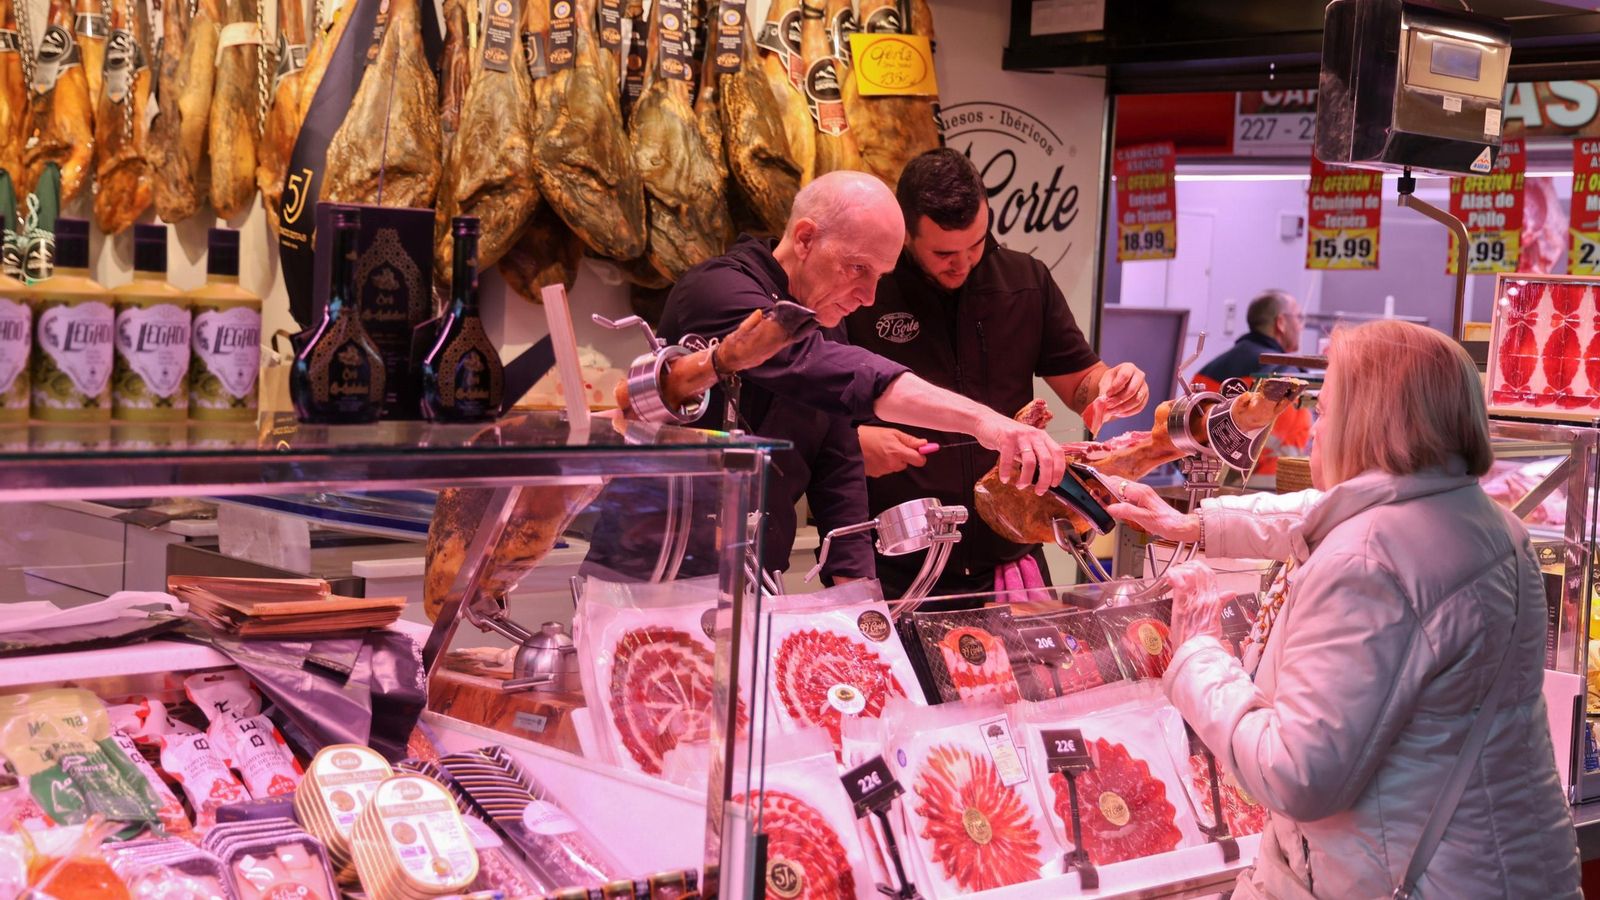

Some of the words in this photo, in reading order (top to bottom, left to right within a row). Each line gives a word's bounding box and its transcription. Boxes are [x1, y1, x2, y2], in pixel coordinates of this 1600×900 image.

[1503, 81, 1599, 128] AS
[943, 110, 984, 131] uesos
[1000, 110, 1054, 156] Ibéricos
[1241, 117, 1278, 141] 227
[1299, 116, 1315, 140] 2
[1582, 142, 1600, 154] CA
[284, 168, 314, 224] 5J
[1365, 194, 1379, 209] de
[1461, 193, 1493, 209] Alas
[1495, 193, 1514, 208] de
[1325, 214, 1368, 228] Ternera
[1468, 211, 1506, 228] Pollo
[1470, 241, 1505, 263] ,99
[1035, 636, 1056, 649] 20€
[1054, 739, 1076, 752] 22€
[857, 771, 882, 794] 22€
[774, 866, 790, 889] 5J
